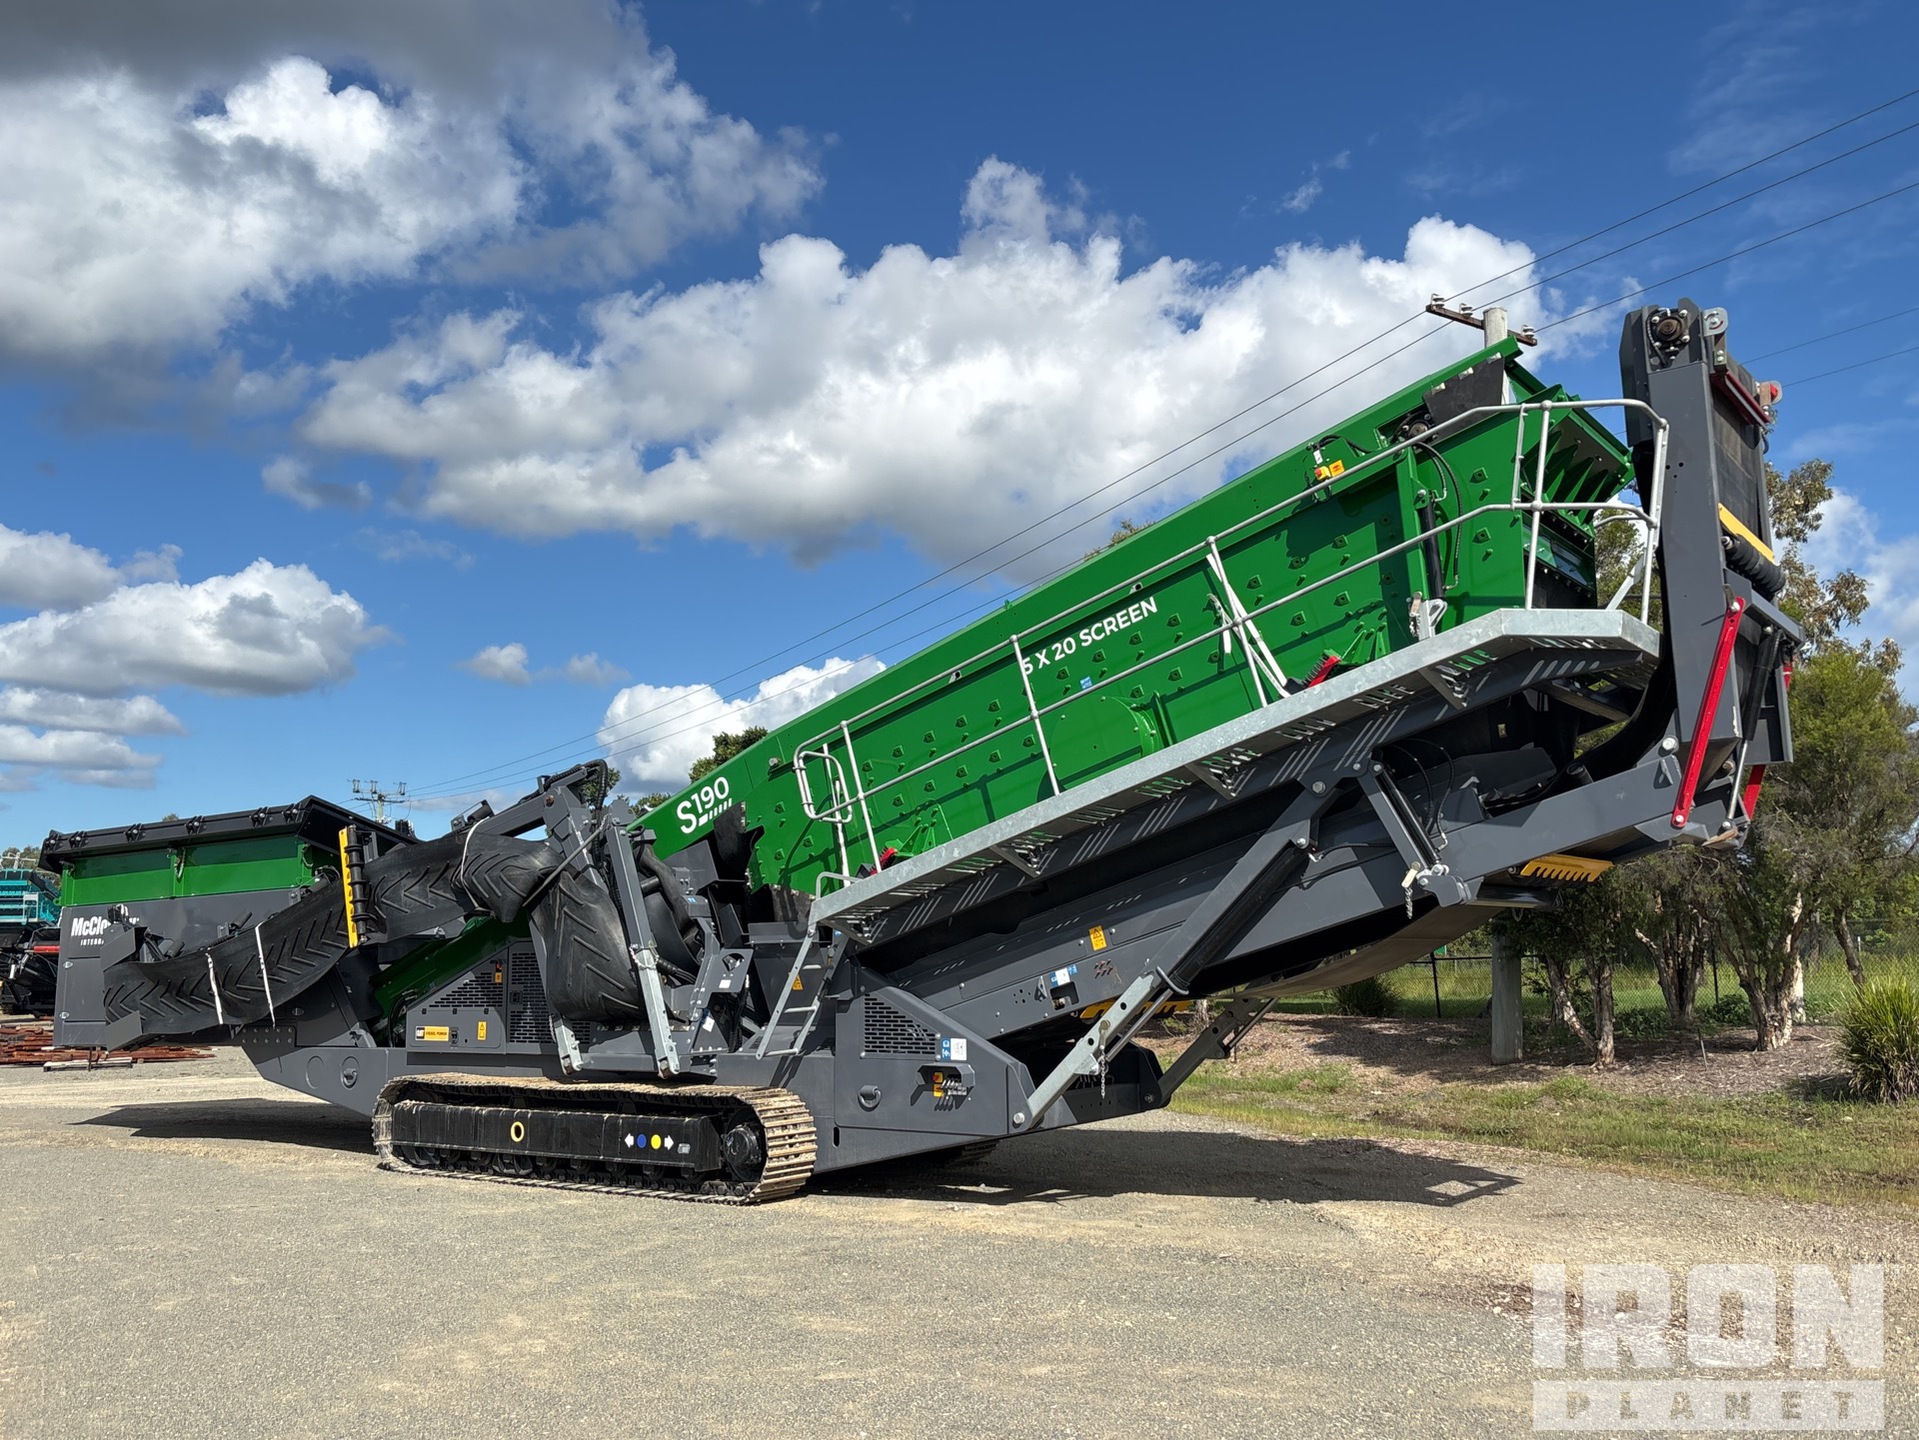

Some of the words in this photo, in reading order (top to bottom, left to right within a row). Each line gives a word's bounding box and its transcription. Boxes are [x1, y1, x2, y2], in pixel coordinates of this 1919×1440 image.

[1035, 649, 1051, 669] X
[1051, 637, 1076, 661] 20
[1079, 596, 1158, 647] SCREEN
[677, 776, 729, 834] S190
